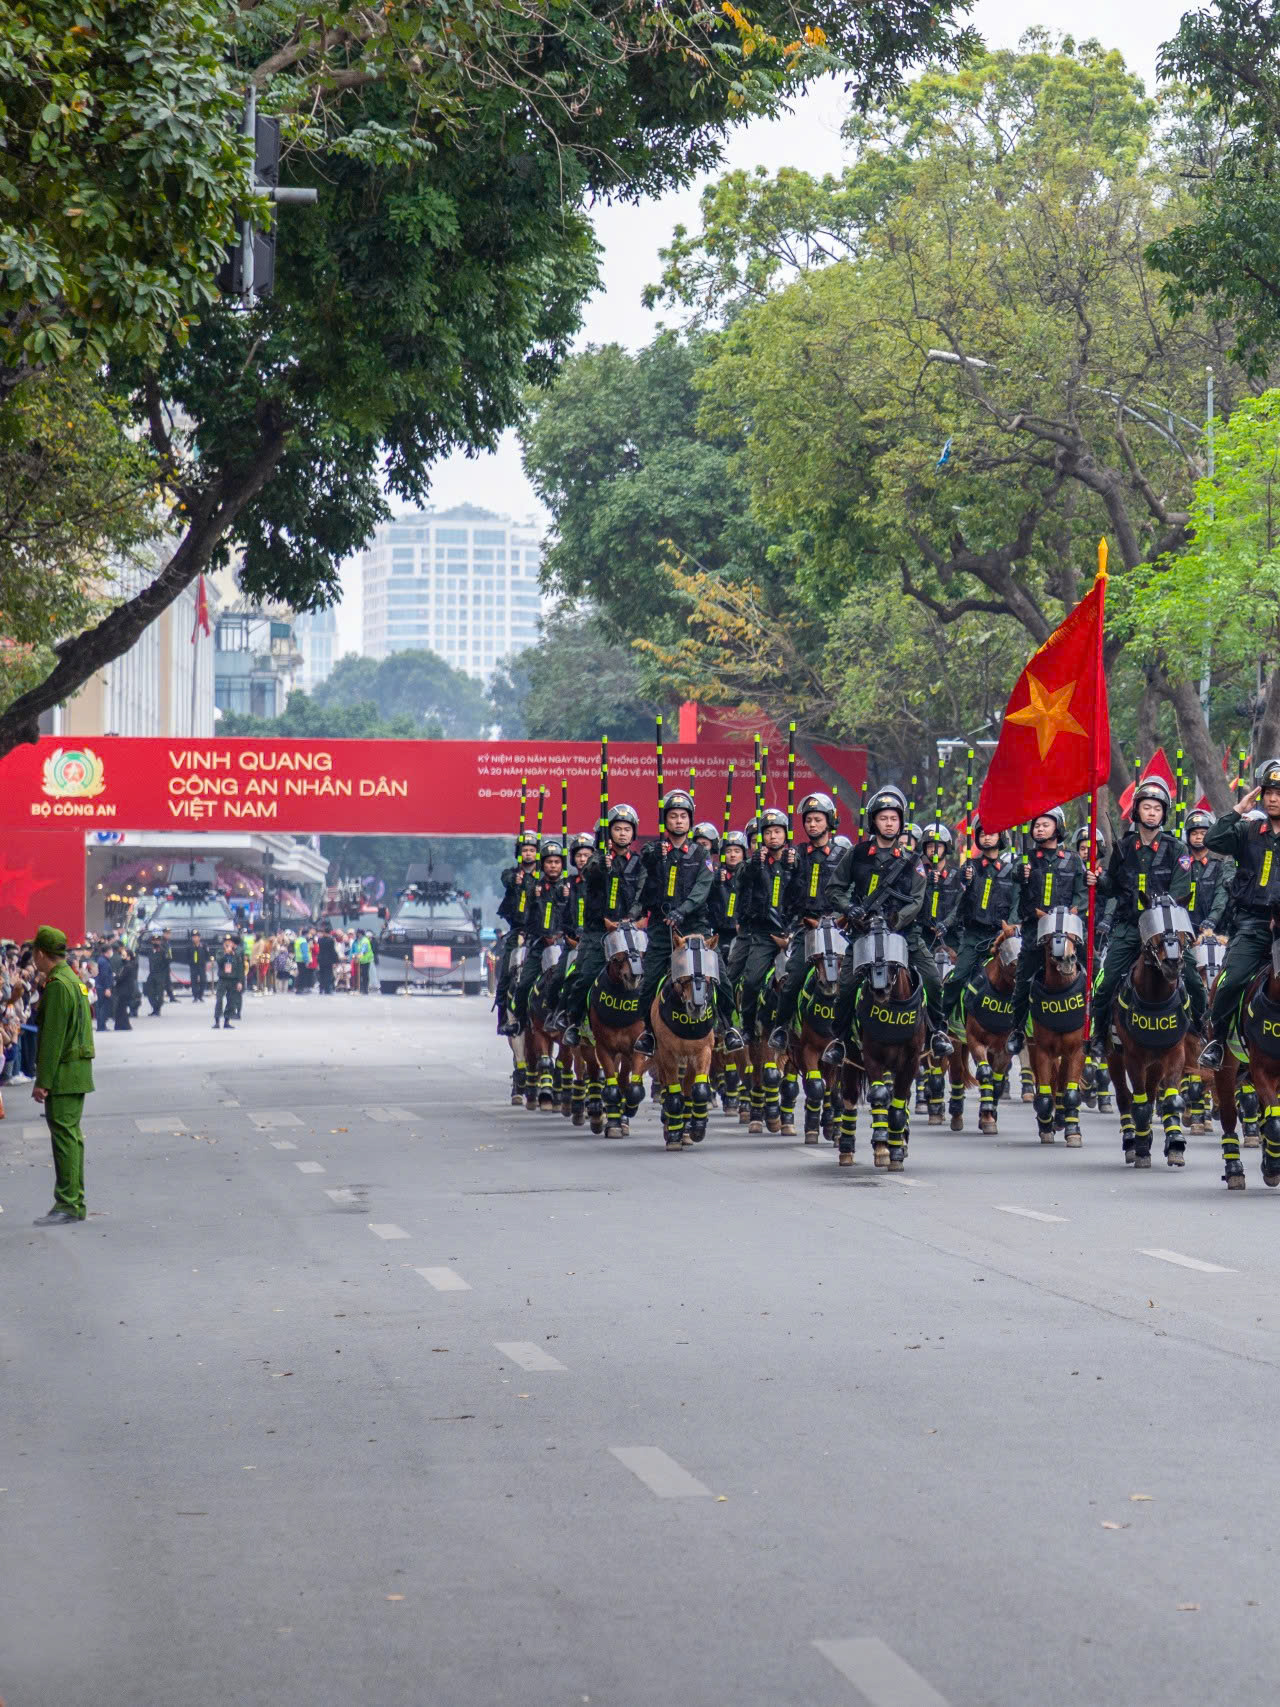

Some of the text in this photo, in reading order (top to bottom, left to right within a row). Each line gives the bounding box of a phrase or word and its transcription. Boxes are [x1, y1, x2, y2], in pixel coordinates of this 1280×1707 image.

[168, 751, 333, 772] VINH QUANG
[514, 755, 525, 764] 80
[491, 767, 502, 776] 20
[168, 775, 408, 797] CÔNG AN NHÂN DÂN
[31, 802, 116, 817] BỘ CÔNG AN
[168, 800, 278, 822] VIỆT NAM
[599, 991, 639, 1011] POLICE
[981, 995, 1014, 1014] POLIC
[1041, 994, 1085, 1013] POLICE
[869, 1005, 917, 1025] POLICE
[1131, 1012, 1177, 1030] POLICE
